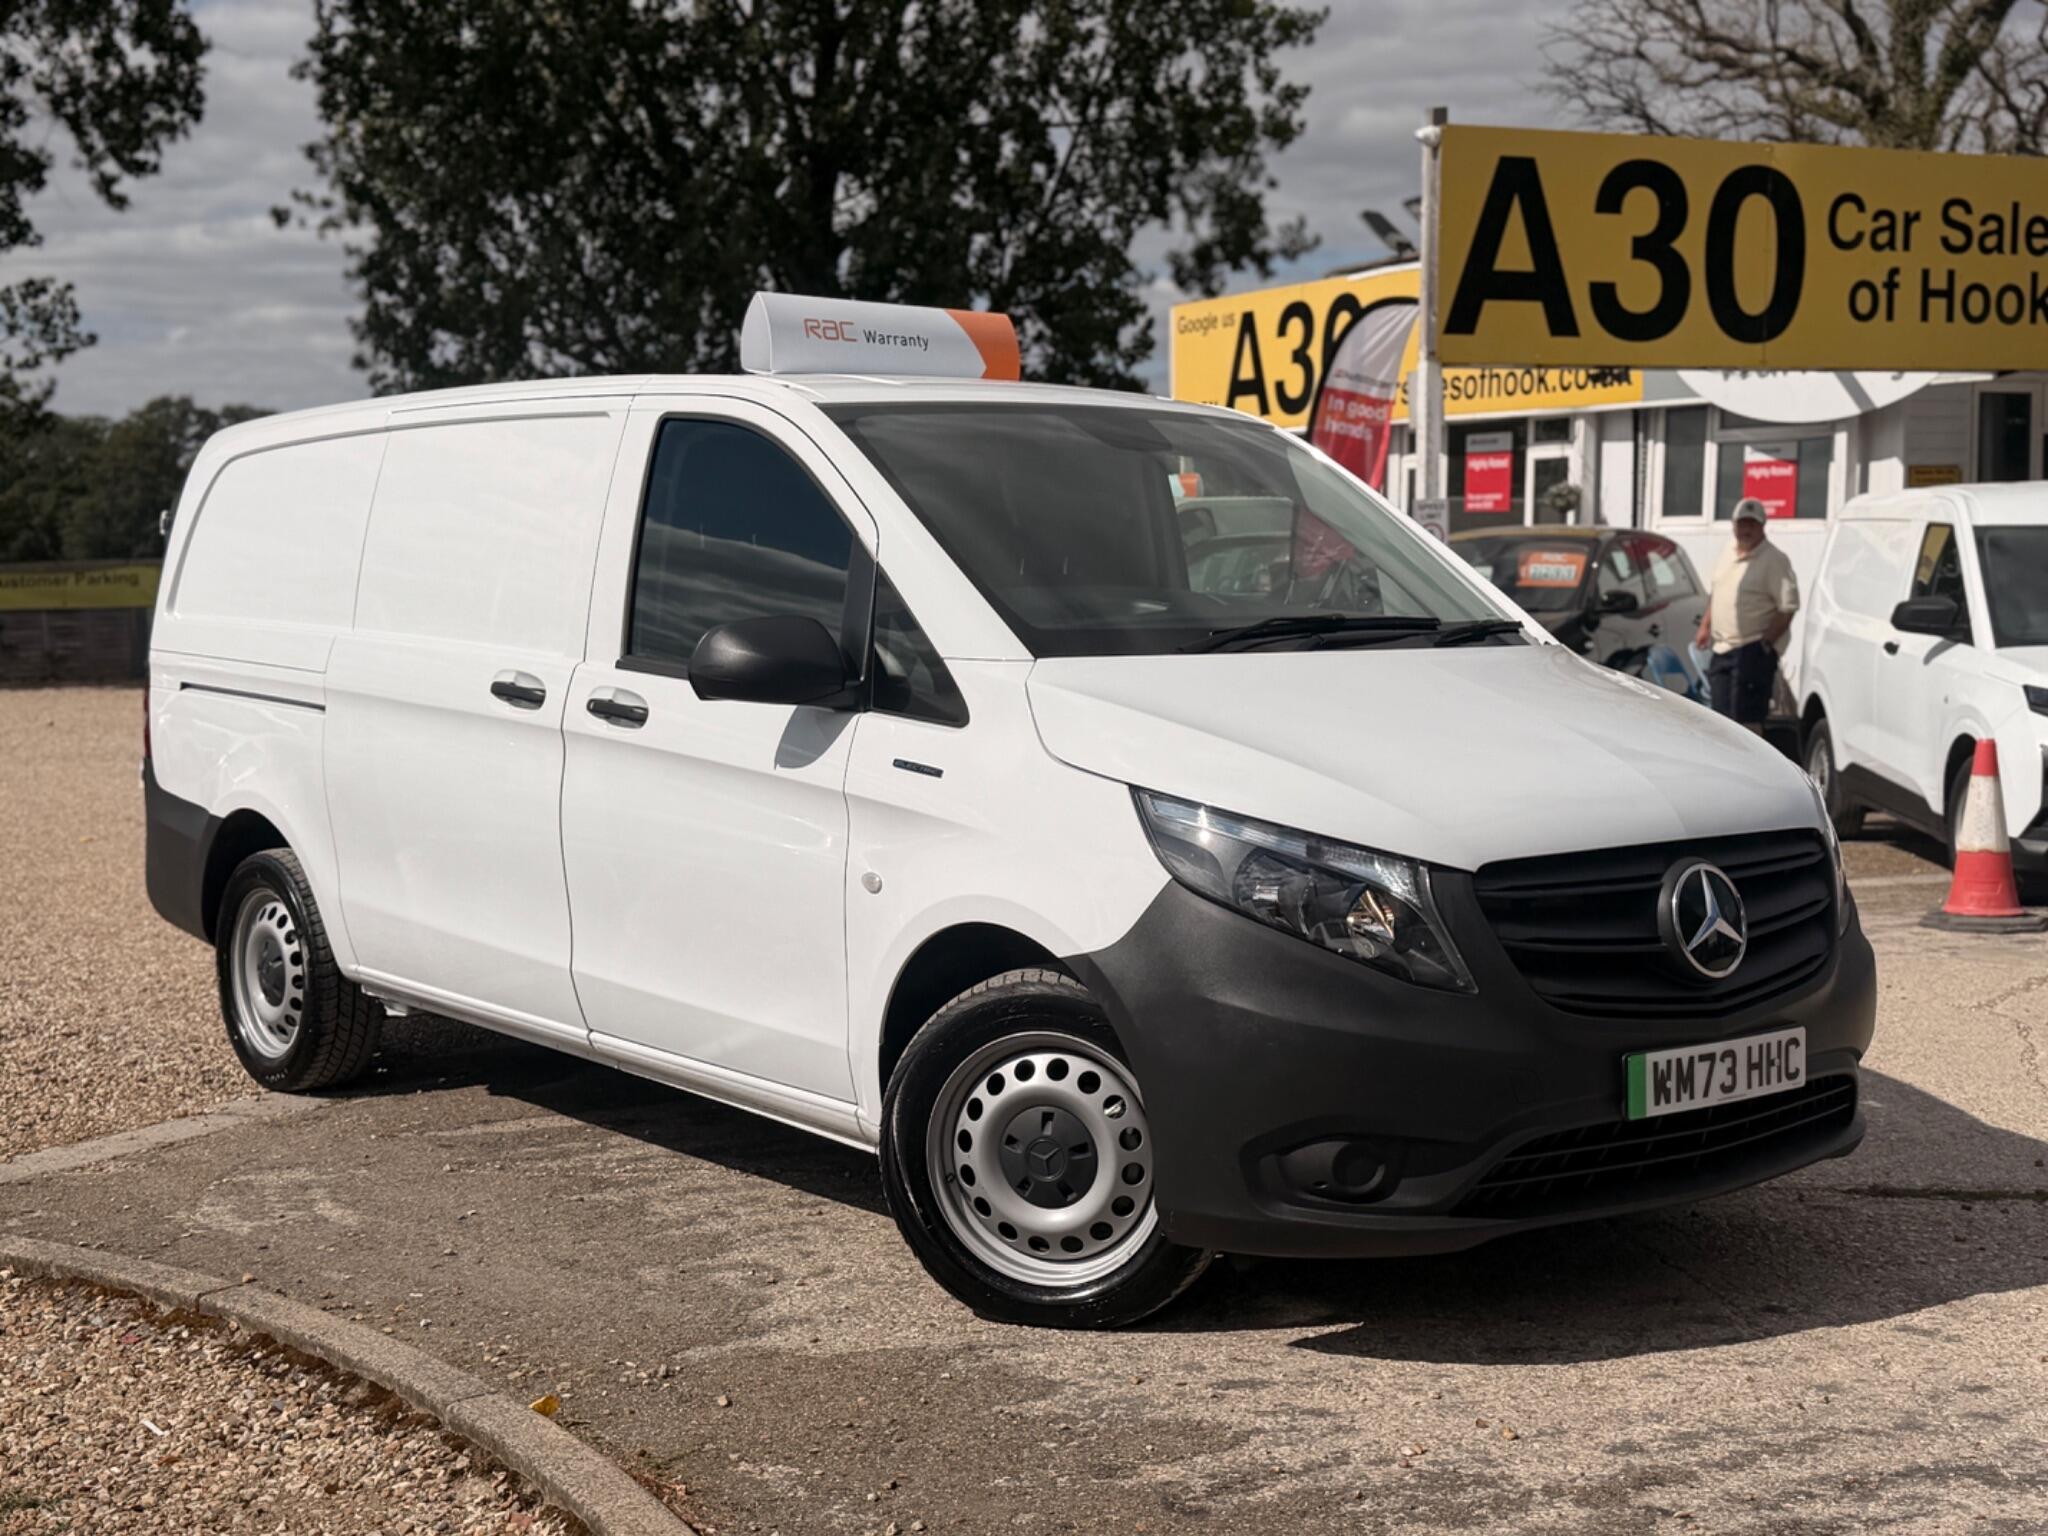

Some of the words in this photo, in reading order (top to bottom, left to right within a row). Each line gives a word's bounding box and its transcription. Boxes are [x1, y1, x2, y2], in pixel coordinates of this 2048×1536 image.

[1827, 191, 1921, 252] Car
[1940, 197, 2048, 257] Sale
[1443, 154, 1806, 344] A30
[1849, 266, 1900, 323] of
[1920, 267, 2048, 326] Hook
[1177, 312, 1217, 336] Google
[1222, 312, 1235, 328] us
[863, 329, 929, 352] Warranty
[1347, 400, 1388, 421] good
[1325, 415, 1373, 440] hands
[0, 574, 69, 589] ustomer
[75, 570, 140, 588] Parking
[1653, 1049, 1737, 1107] WM73
[1746, 1036, 1800, 1091] HHC
